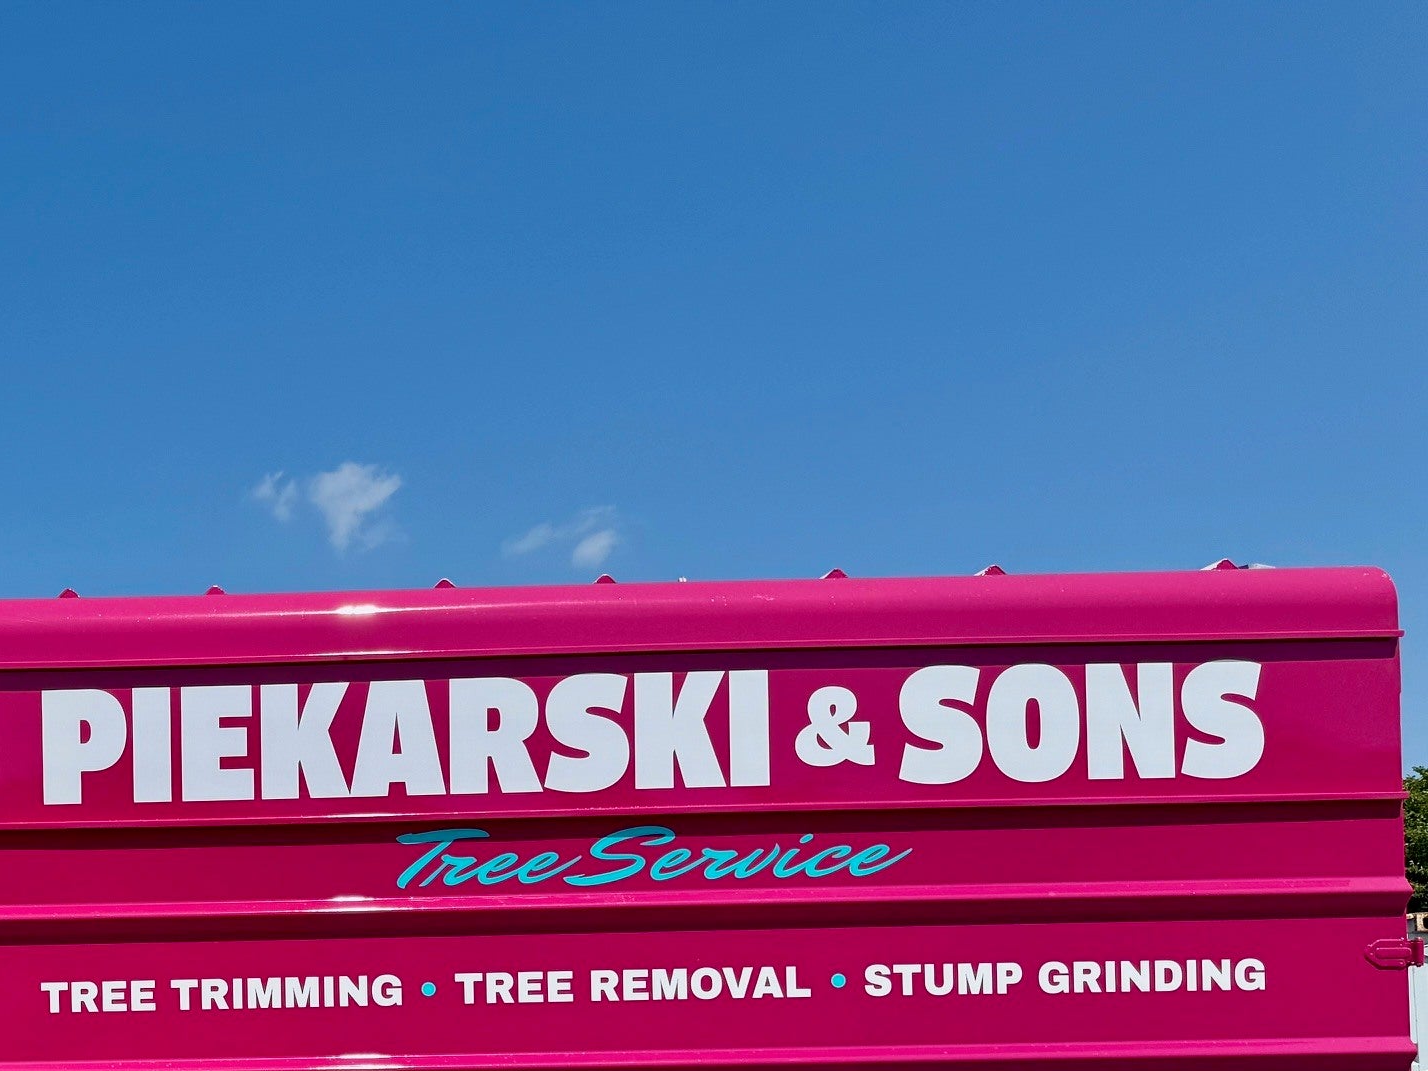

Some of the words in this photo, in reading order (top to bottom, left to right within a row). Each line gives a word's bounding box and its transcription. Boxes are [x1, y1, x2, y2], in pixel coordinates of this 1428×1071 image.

[41, 670, 771, 806] PIEKARSKI
[794, 685, 876, 768] &
[898, 659, 1265, 785] SONS
[396, 828, 582, 889] Tree
[565, 826, 913, 887] Service
[41, 980, 157, 1014] TREE
[170, 974, 403, 1011] TRIMMING
[455, 971, 574, 1005] TREE
[590, 966, 812, 1002] REMOVAL
[864, 962, 1023, 997] STUMP
[1038, 957, 1266, 994] GRINDING
